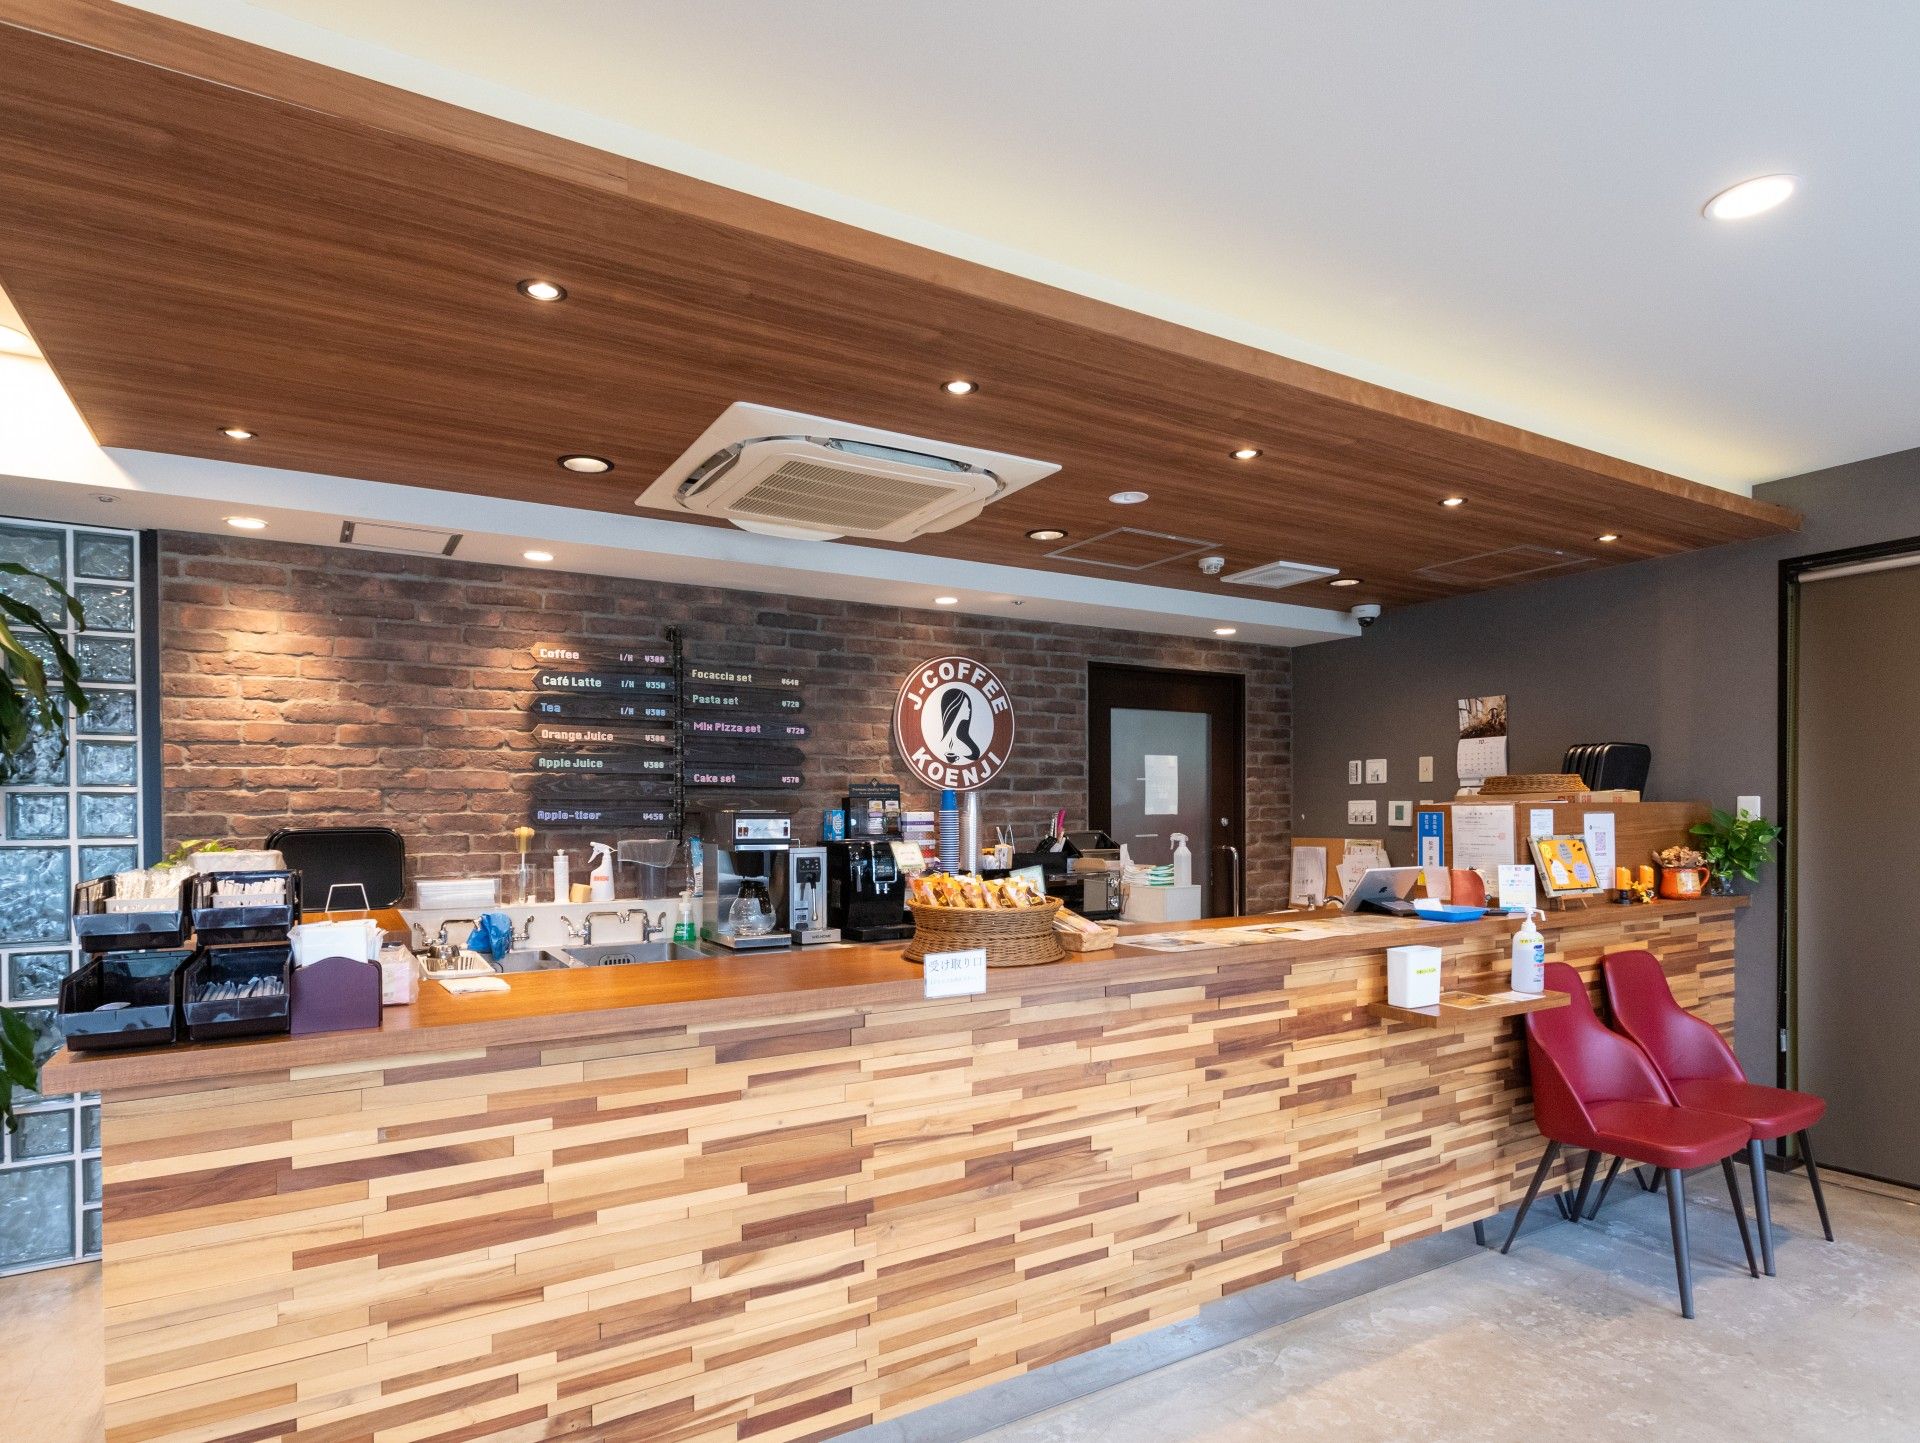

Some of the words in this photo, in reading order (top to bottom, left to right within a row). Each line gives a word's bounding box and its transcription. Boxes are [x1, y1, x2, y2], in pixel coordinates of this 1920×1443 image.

[540, 648, 580, 660] Coffee
[542, 675, 570, 686] Café
[571, 676, 602, 688] Latte
[691, 669, 735, 681] Focaccia
[736, 674, 752, 683] set
[907, 662, 1008, 715] J-COFFEE
[692, 694, 721, 705] Pasta
[723, 696, 739, 705] set
[540, 702, 561, 713] Tea
[693, 721, 713, 731] Mix
[714, 722, 744, 733] Pizza
[745, 724, 762, 733] set
[541, 729, 581, 742] Orange
[583, 731, 614, 741] Juice
[538, 757, 571, 769] Apple
[572, 758, 604, 768] Juice
[911, 746, 1002, 787] KOENJI
[693, 773, 718, 783] Cake
[720, 774, 736, 783] set
[537, 810, 602, 821] Apple-tiser
